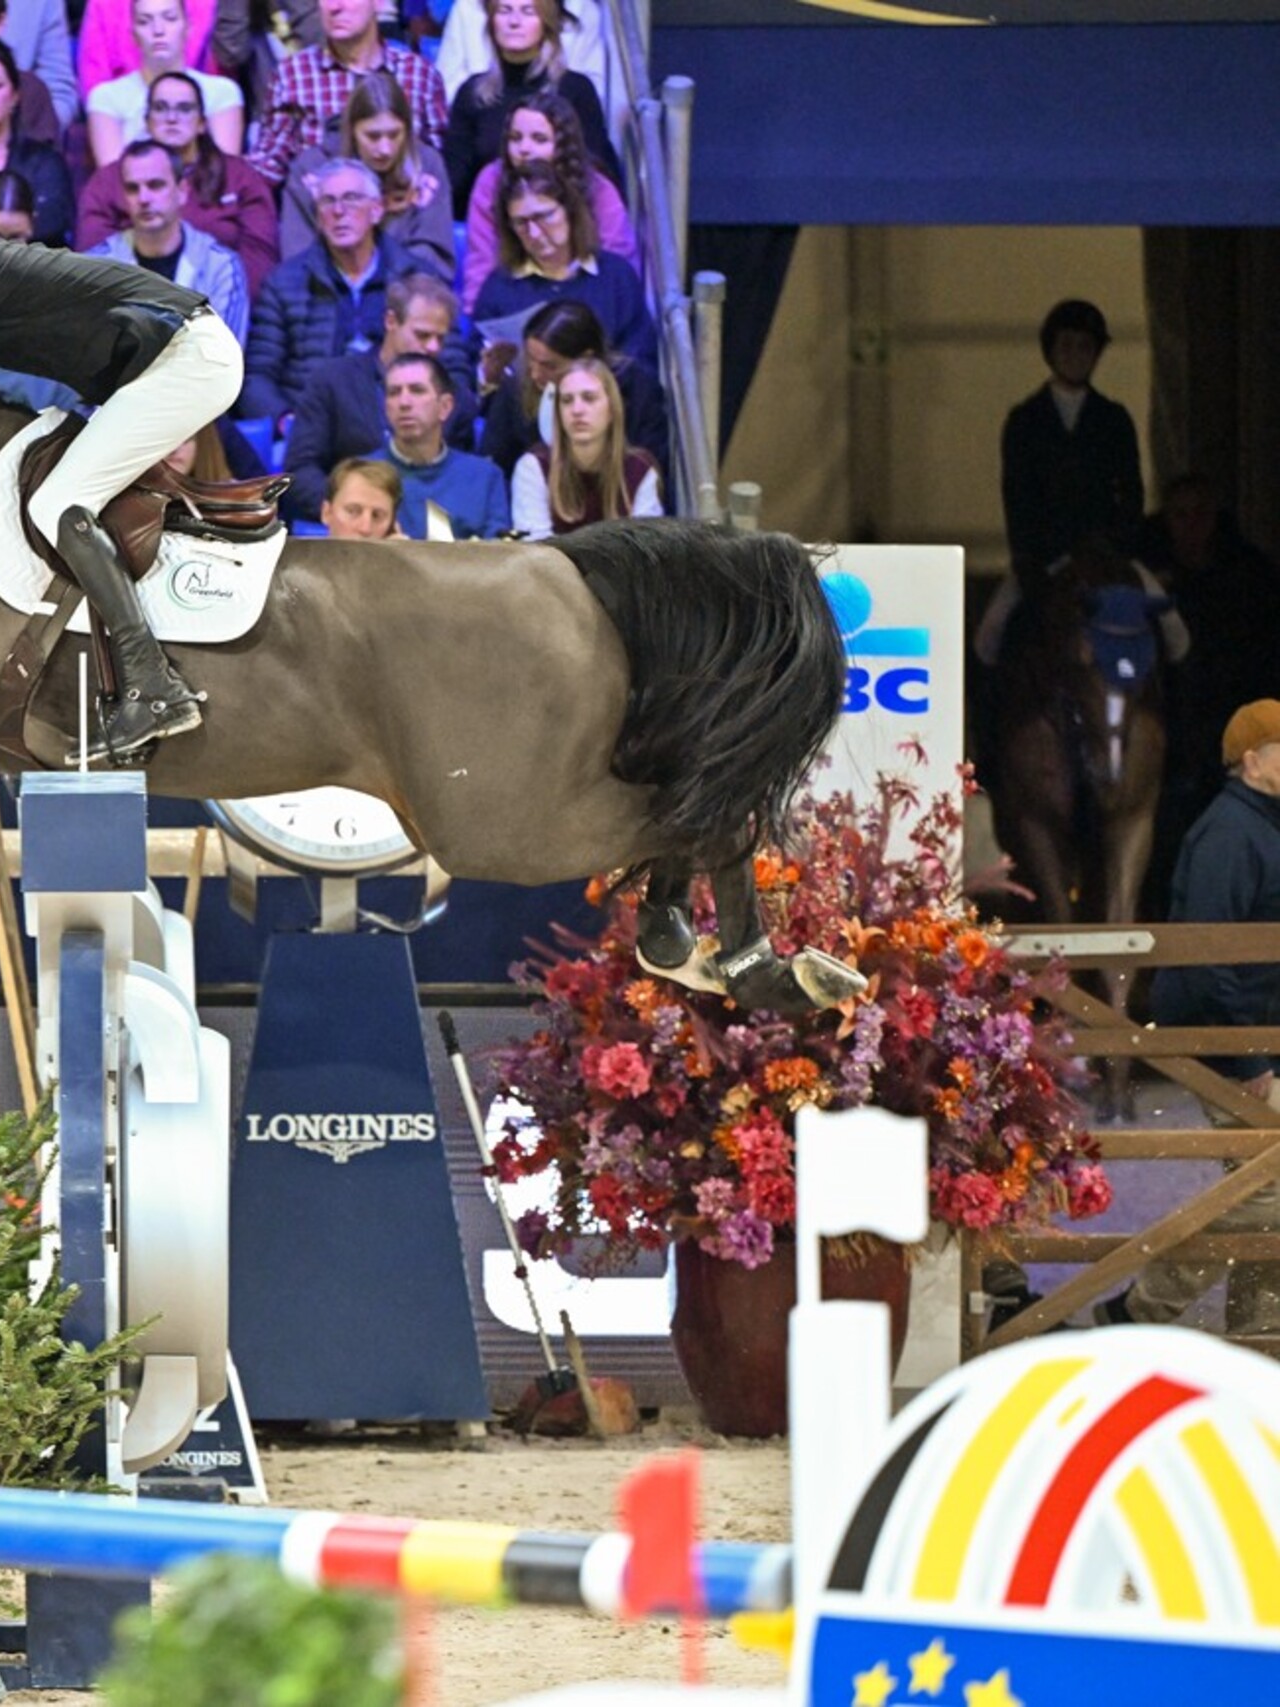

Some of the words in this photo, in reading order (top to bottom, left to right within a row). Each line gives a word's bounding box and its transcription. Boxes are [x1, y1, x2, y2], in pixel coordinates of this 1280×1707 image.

[840, 667, 930, 715] BC
[246, 1113, 436, 1142] LONGINES
[161, 1450, 241, 1466] ONGINES
